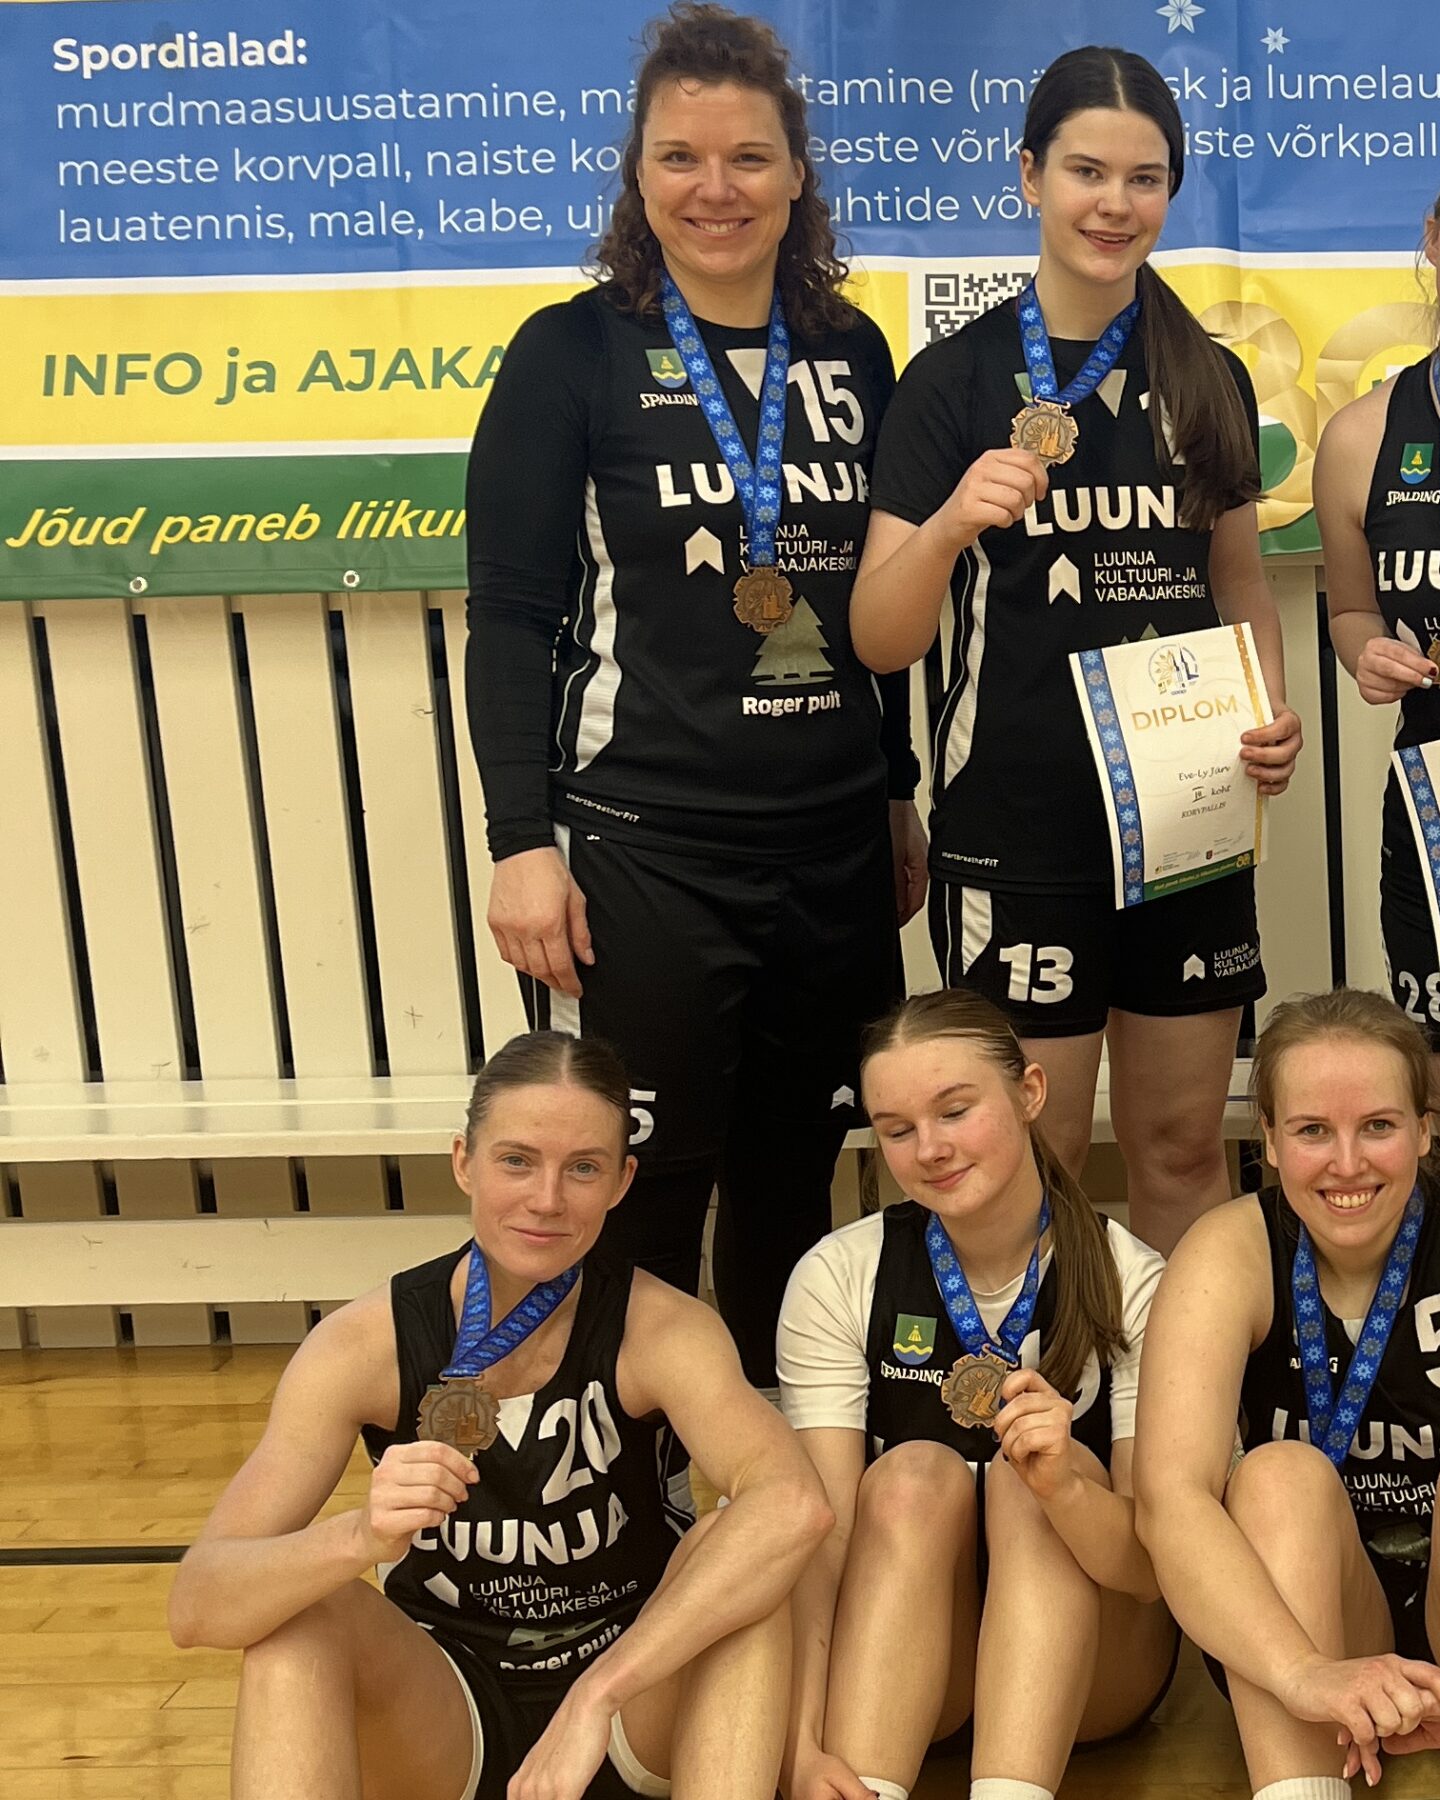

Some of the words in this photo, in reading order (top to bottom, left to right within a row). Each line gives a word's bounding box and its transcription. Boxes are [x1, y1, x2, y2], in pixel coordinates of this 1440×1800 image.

[51, 29, 309, 79] Spordialad:
[56, 82, 567, 130] murdmaasuusatamine,
[1215, 67, 1252, 109] ja
[57, 152, 220, 188] meeste
[233, 144, 412, 188] korvpall,
[426, 139, 556, 178] naiste
[57, 205, 295, 245] lauatennis,
[309, 200, 425, 241] male,
[438, 196, 553, 237] kabe,
[41, 351, 203, 398] INFO
[213, 346, 278, 406] ja
[296, 344, 508, 393] AJAKA
[640, 392, 700, 410] SPALDIN
[786, 358, 865, 447] 15
[655, 461, 870, 509] LUNJA
[5, 506, 147, 549] Jõud
[149, 502, 322, 555] paneb
[336, 498, 467, 541] liiku
[738, 523, 810, 540] LNJA
[1023, 484, 1190, 537] LUUN
[738, 540, 827, 556] KTUURI
[1093, 550, 1157, 568] LUUNJA
[1093, 568, 1173, 586] KULTUURI
[1182, 566, 1198, 582] JA
[1094, 583, 1207, 603] VABAAJAKESKUS
[741, 695, 804, 718] Roger
[807, 690, 842, 716] puit
[1130, 693, 1240, 732] DIPLOM
[999, 941, 1075, 1005] 13
[537, 1380, 622, 1506] 20
[1343, 1472, 1413, 1490] LUUNJA
[468, 1574, 547, 1597] LUUNJA
